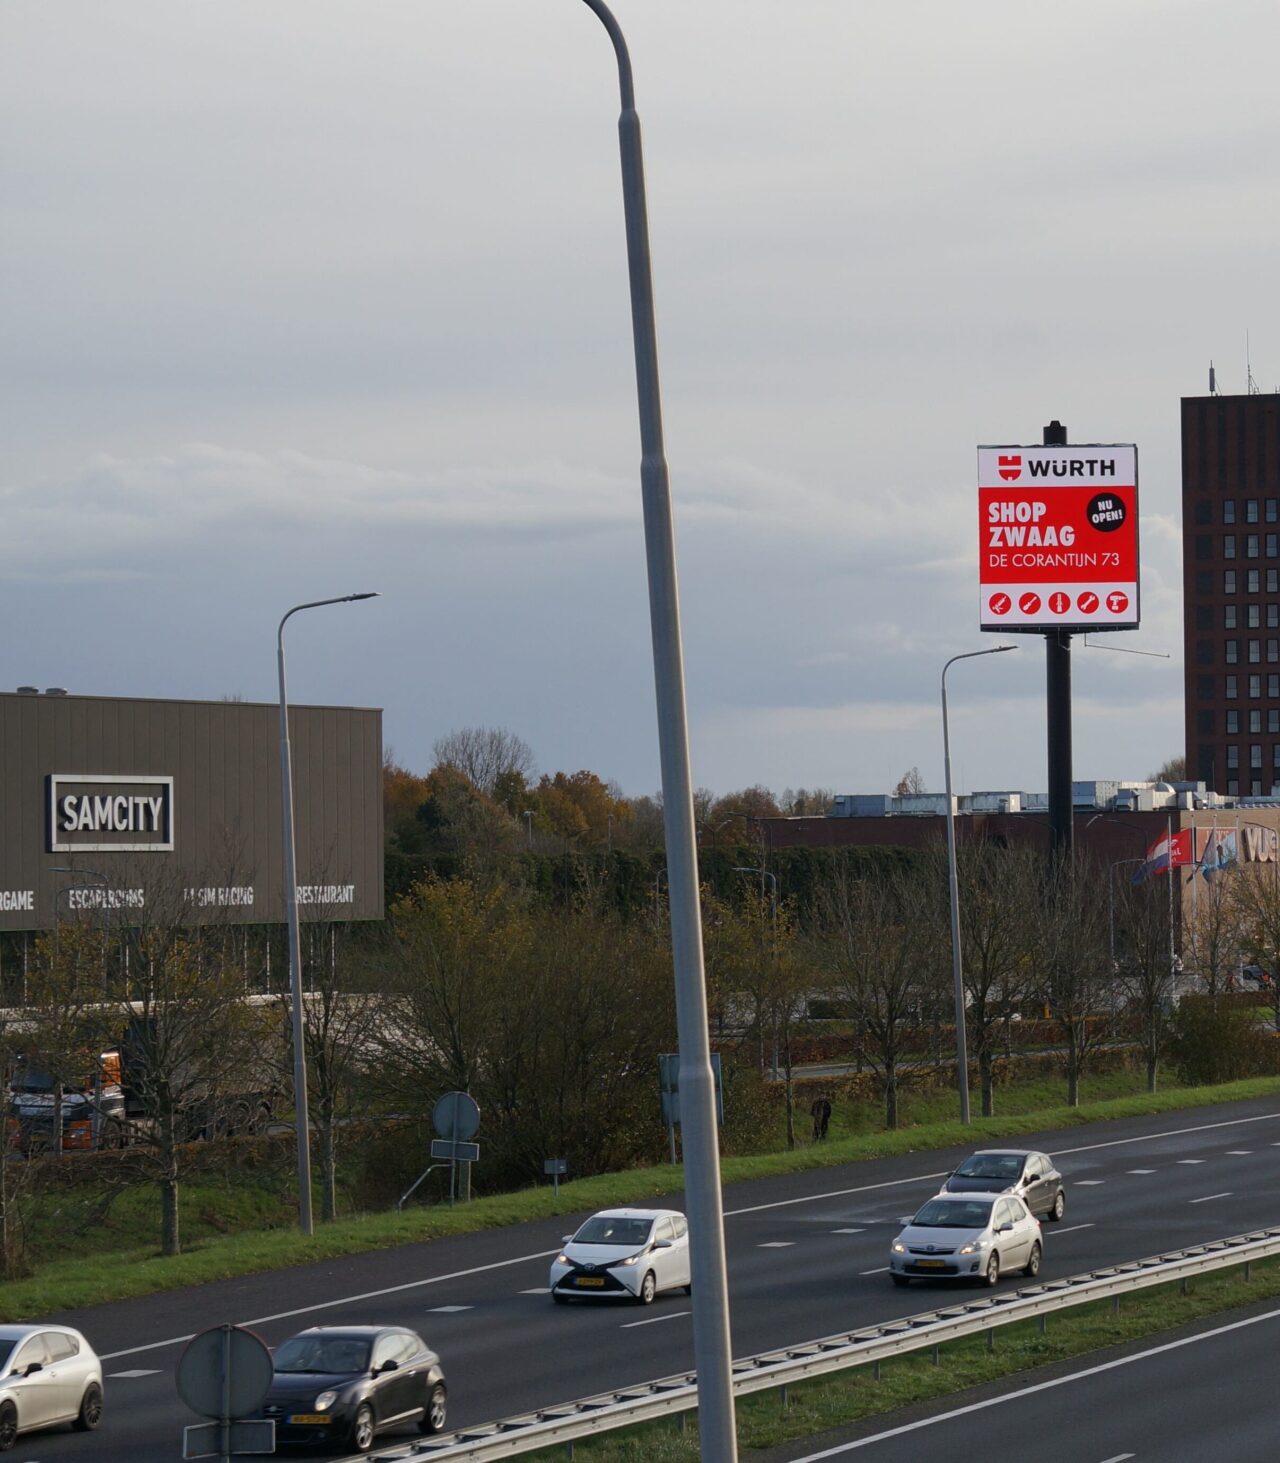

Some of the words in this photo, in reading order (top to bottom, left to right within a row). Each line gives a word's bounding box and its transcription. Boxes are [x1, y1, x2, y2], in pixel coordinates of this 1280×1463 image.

[1028, 459, 1116, 477] WÜRTH
[988, 501, 1047, 523] SHOP
[1097, 500, 1113, 511] NU
[1091, 508, 1123, 524] OPEN!
[988, 525, 1075, 547] ZWAAG
[989, 554, 1008, 568] DE
[1012, 553, 1097, 567] CORANTIJN
[1101, 552, 1120, 566] 73
[63, 795, 163, 832] SAMCITY
[295, 885, 355, 904] RESTAURANT
